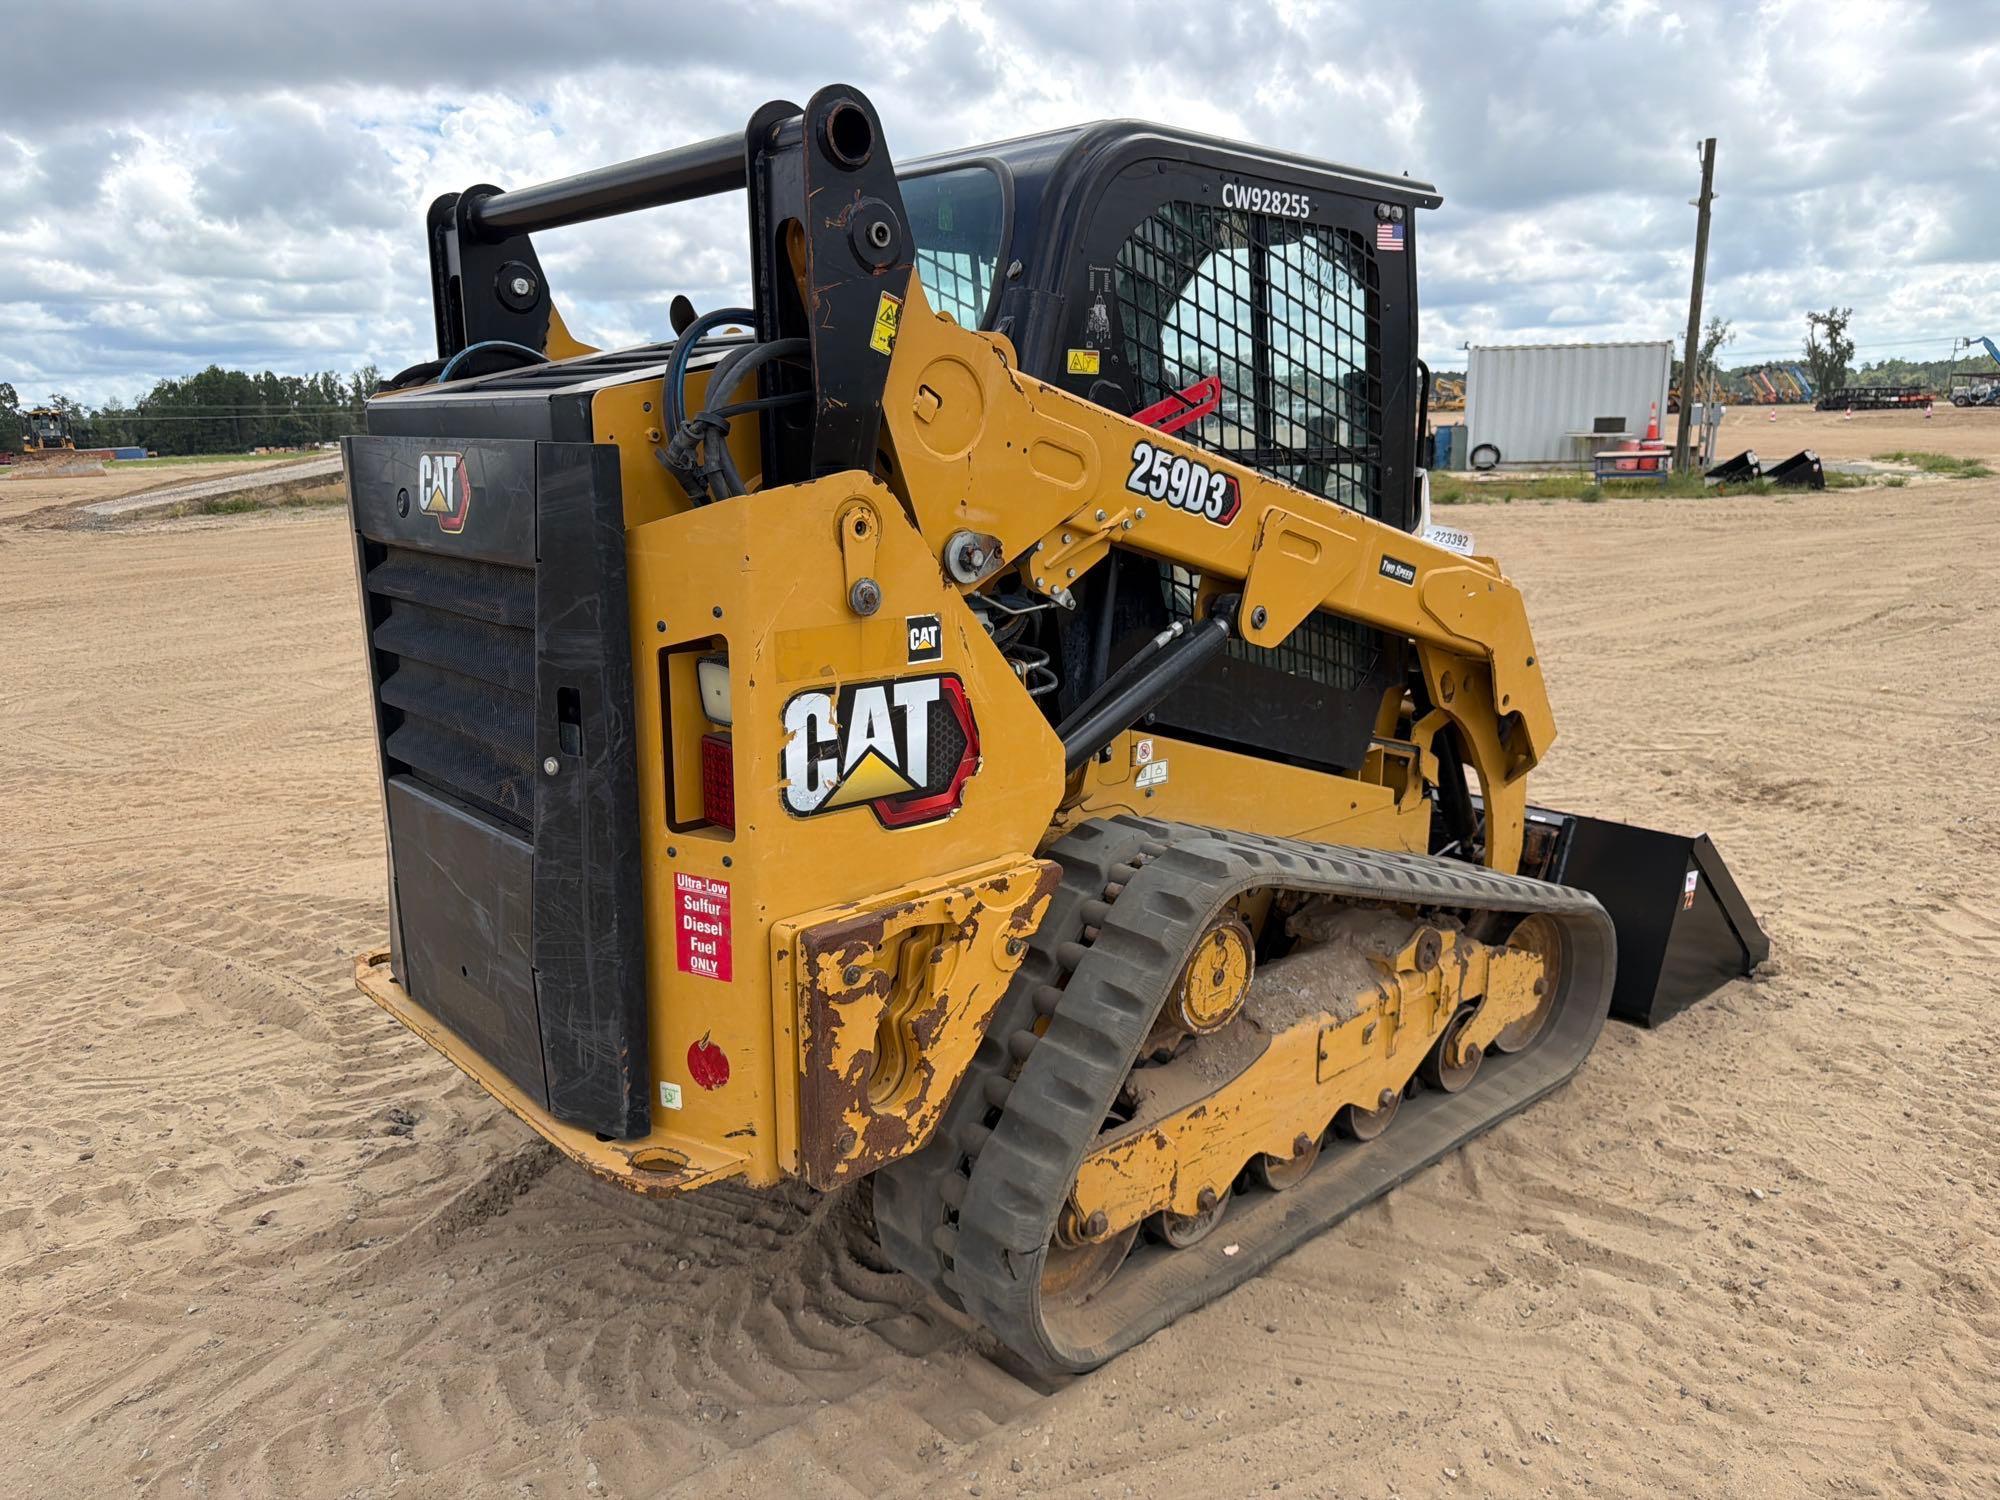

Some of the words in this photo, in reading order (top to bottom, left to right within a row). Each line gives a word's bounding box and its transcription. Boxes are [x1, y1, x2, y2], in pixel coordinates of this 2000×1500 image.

[1222, 183, 1310, 219] CW928255
[420, 454, 457, 512] CAT
[1128, 442, 1227, 519] 259D3
[1433, 531, 1469, 547] 223392
[910, 626, 938, 650] CAT
[785, 678, 940, 812] CAT
[677, 873, 728, 895] Ultra-Low
[684, 895, 721, 915] Sulfur
[683, 915, 723, 936] Diesel
[691, 937, 717, 955] Fuel
[690, 956, 719, 973] ONLY
